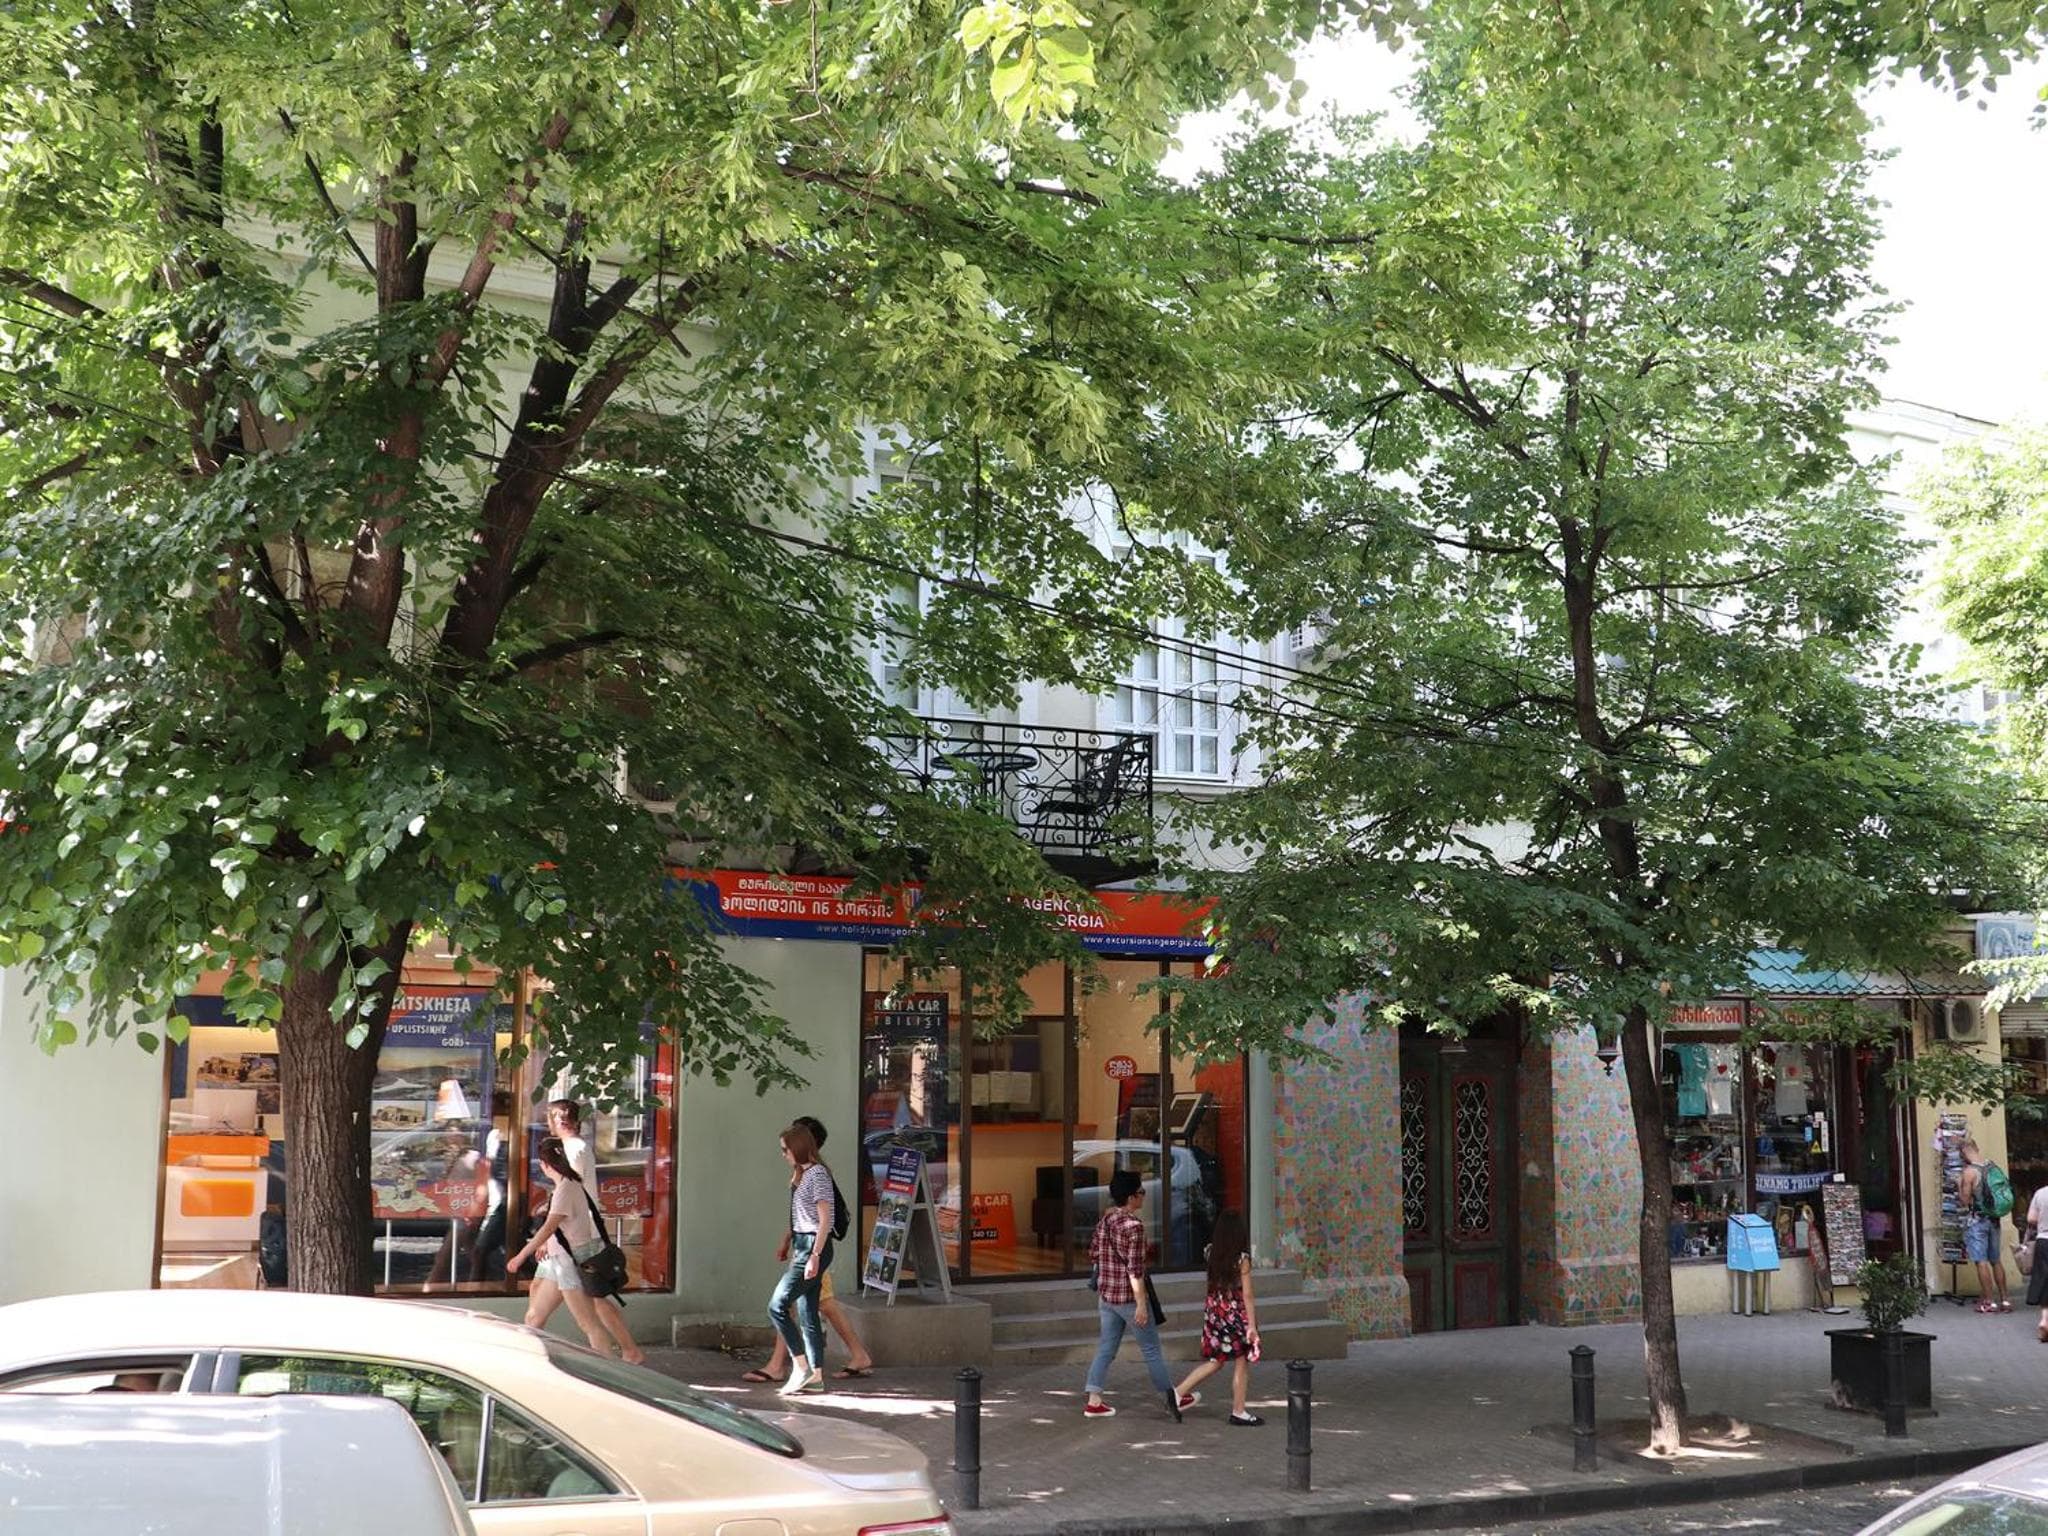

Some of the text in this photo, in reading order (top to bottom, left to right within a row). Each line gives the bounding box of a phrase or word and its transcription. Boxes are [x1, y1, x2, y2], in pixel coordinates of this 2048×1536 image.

[811, 900, 830, 915] ინ
[918, 999, 940, 1011] CAR
[434, 1183, 475, 1195] Let's
[600, 1182, 638, 1194] Let's
[615, 1194, 638, 1208] go!
[984, 1195, 1008, 1206] CAR
